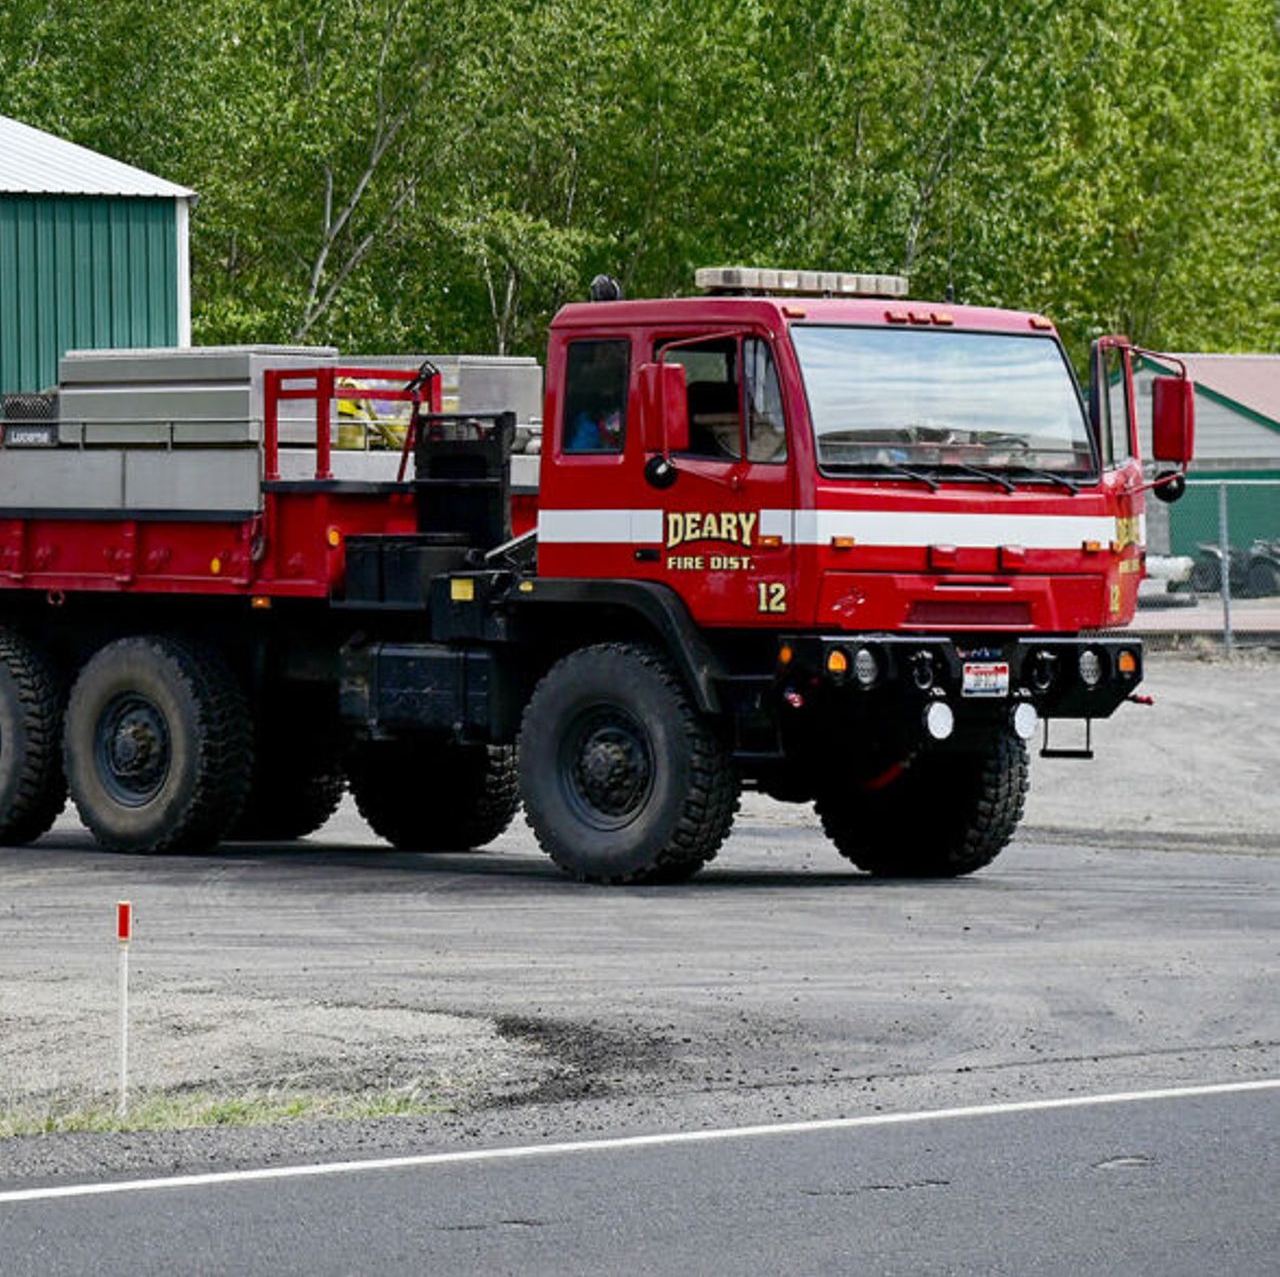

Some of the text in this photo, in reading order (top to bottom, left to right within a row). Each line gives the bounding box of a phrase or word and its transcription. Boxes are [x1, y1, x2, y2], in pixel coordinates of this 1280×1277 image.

[667, 512, 757, 549] DEARY
[667, 556, 755, 570] FIRE DIST.
[758, 582, 786, 613] 12
